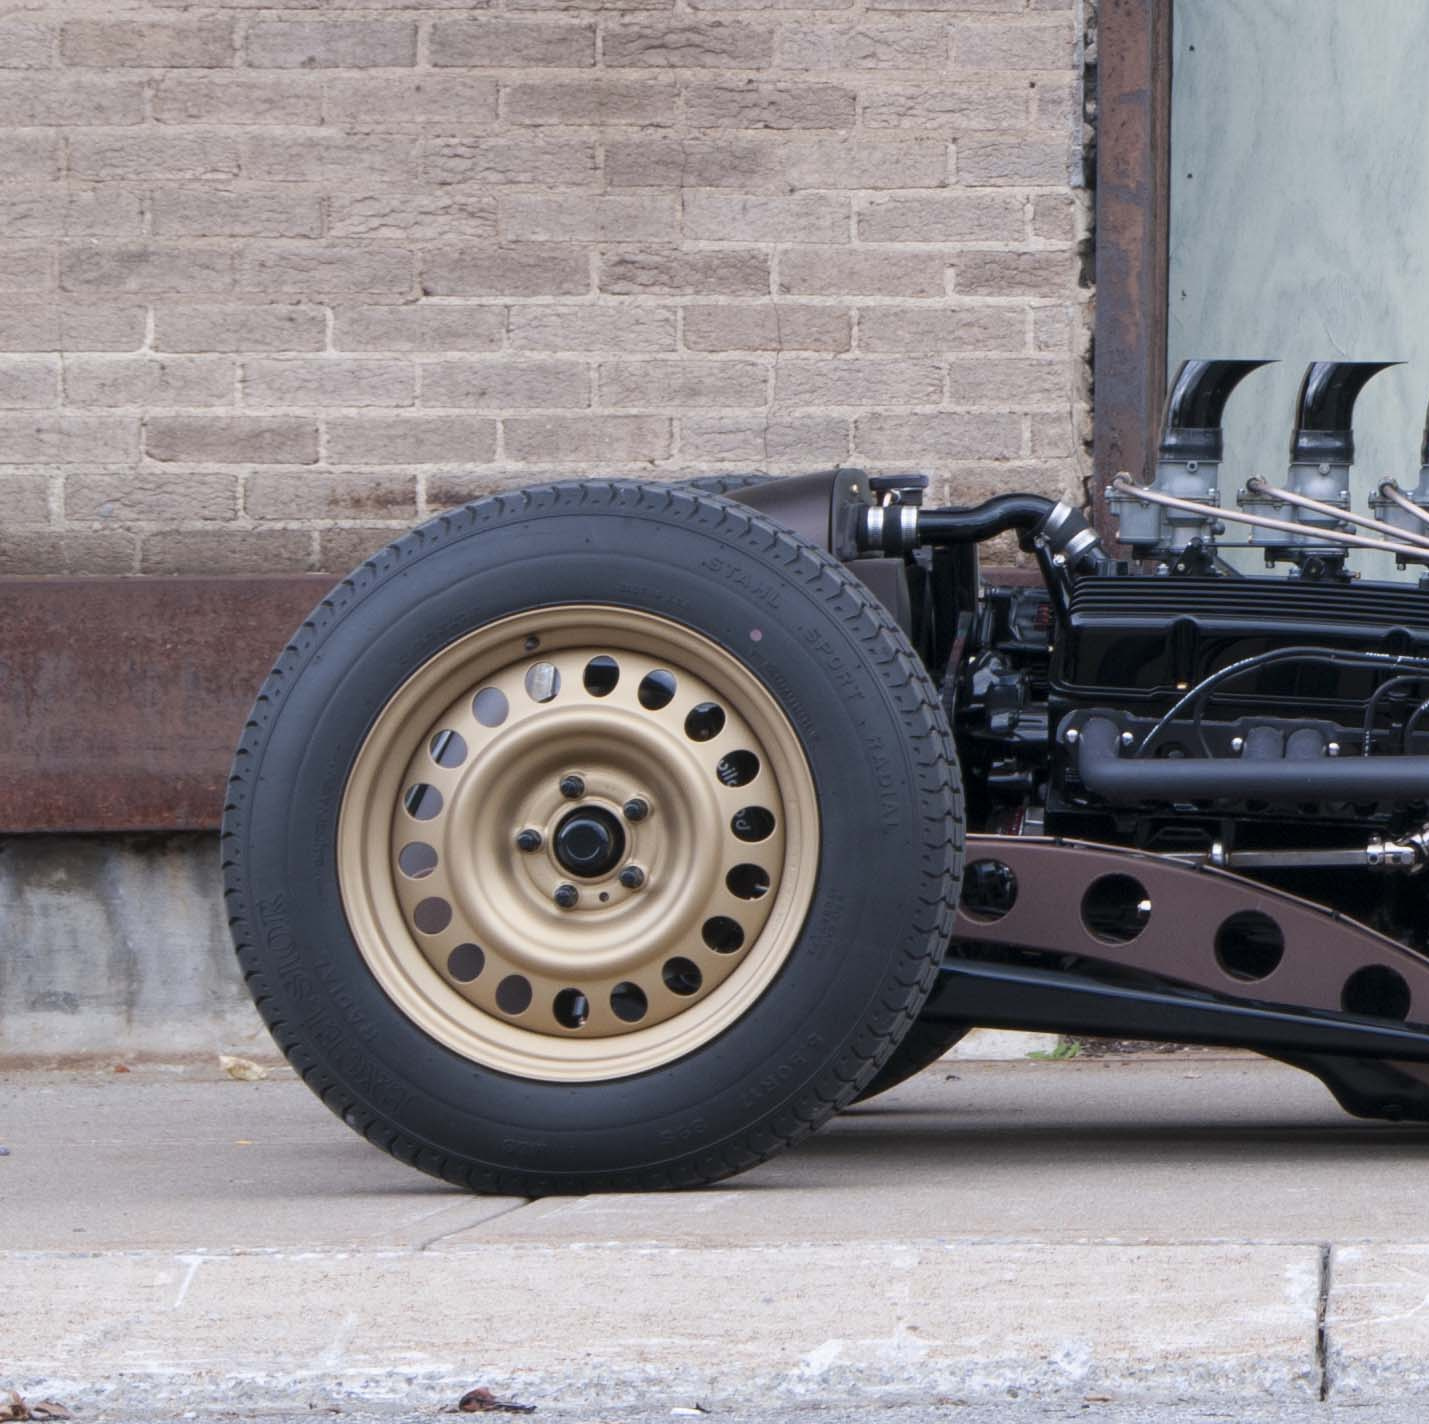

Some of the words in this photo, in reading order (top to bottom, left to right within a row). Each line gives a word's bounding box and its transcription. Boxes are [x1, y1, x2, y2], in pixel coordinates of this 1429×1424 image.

[705, 556, 782, 610] STAHL
[804, 628, 866, 702] SPORT
[863, 734, 900, 833] RADIAL
